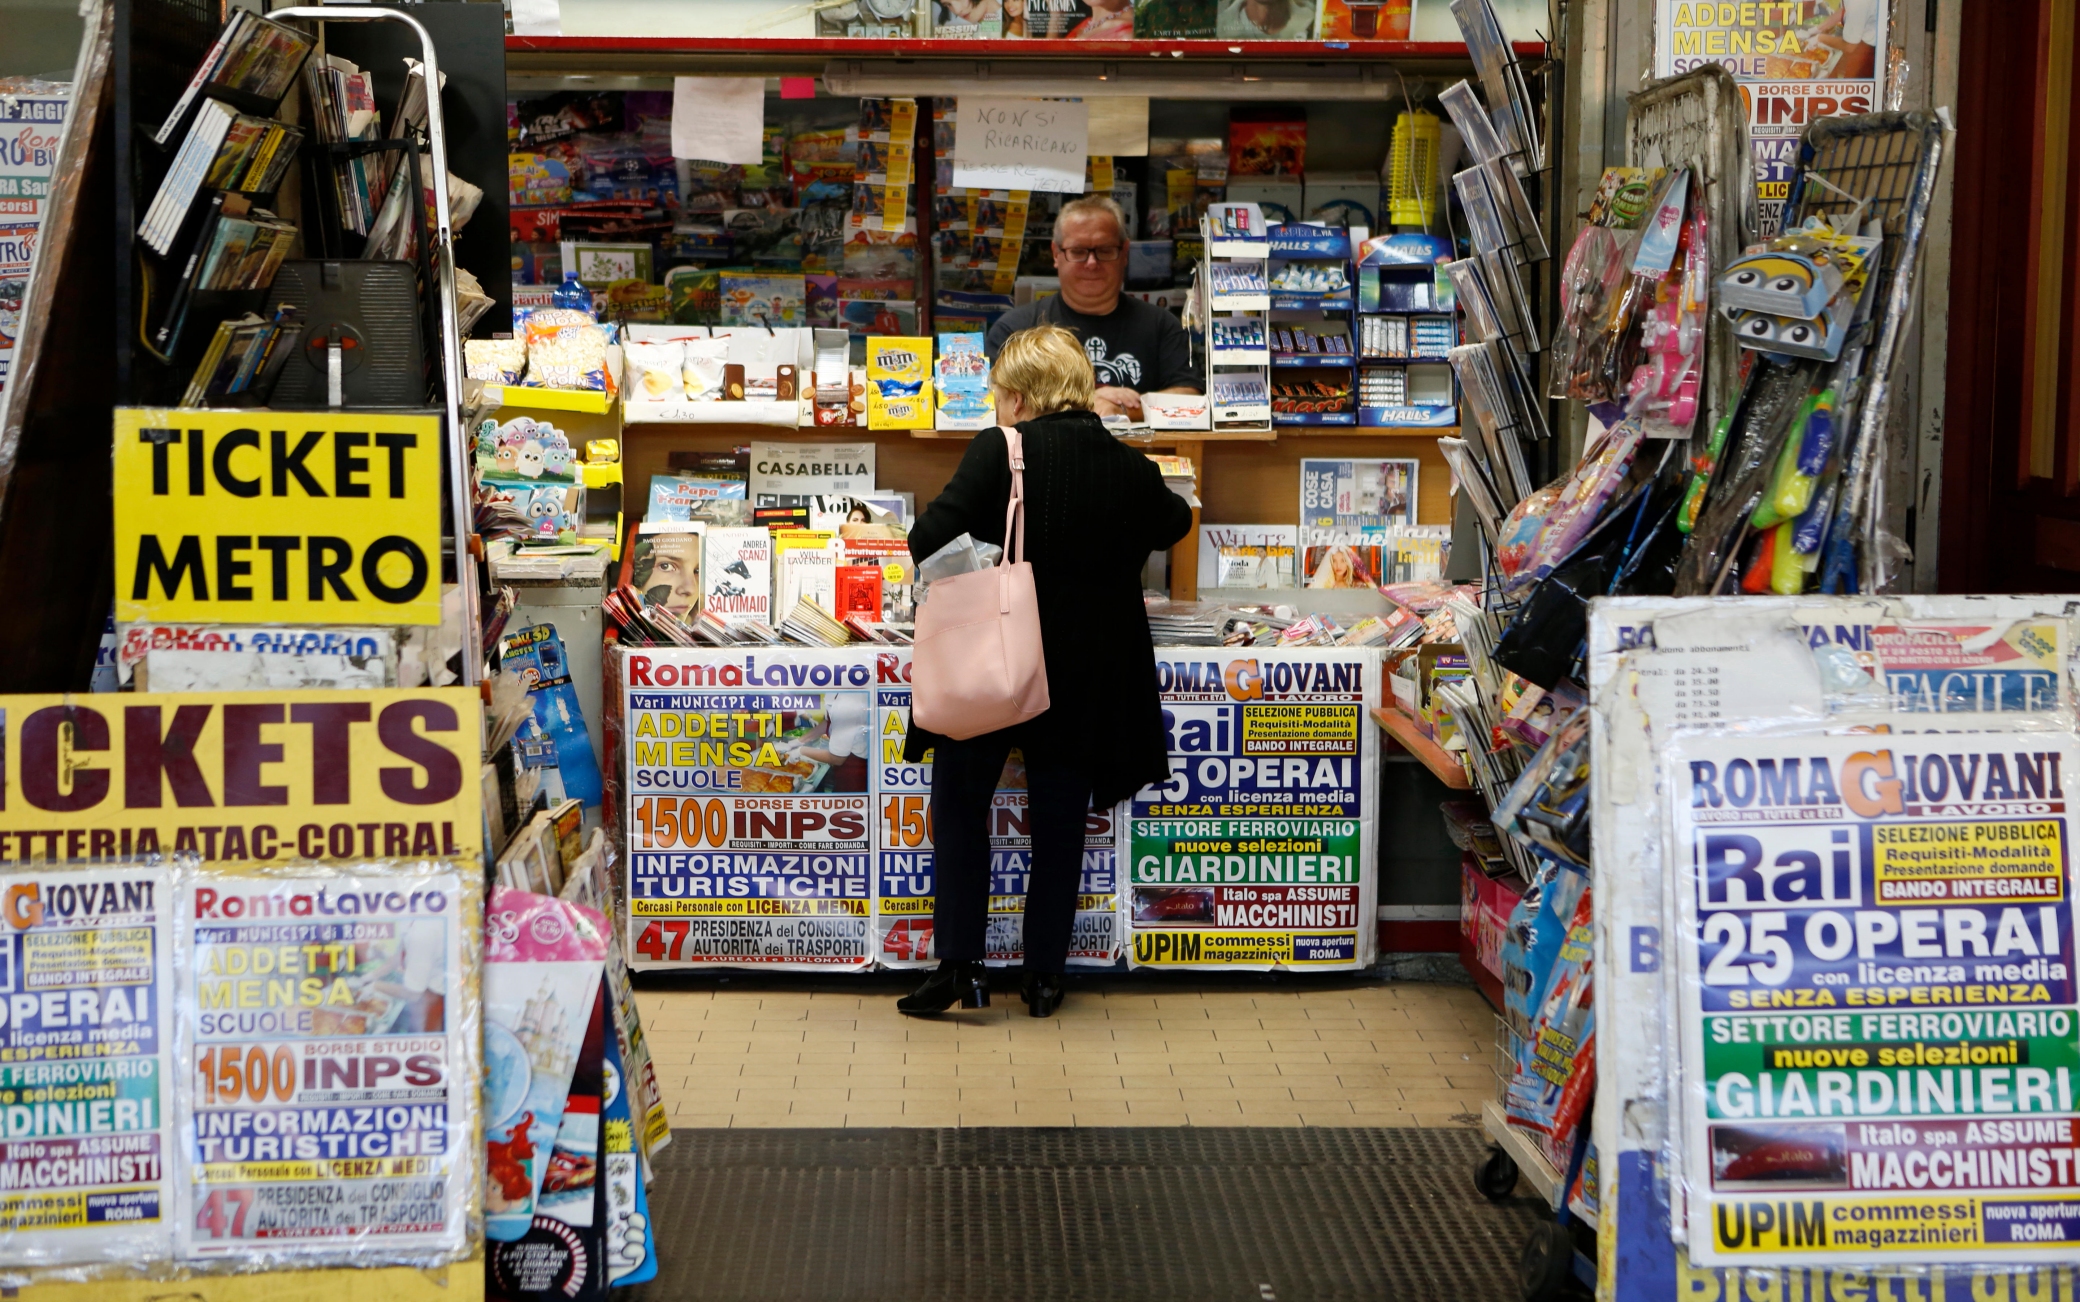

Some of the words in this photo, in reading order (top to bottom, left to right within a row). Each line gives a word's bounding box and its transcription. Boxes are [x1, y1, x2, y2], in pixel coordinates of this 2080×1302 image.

[1673, 2, 1804, 27] ADDETTI
[1673, 30, 1802, 55] MENSA
[1758, 85, 1811, 96] BORSE
[1815, 84, 1871, 95] STUDIO
[978, 108, 1030, 127] NON
[1757, 97, 1870, 124] INPS
[1754, 127, 1781, 135] REQUISITI
[1269, 241, 1310, 251] HALLS
[1384, 246, 1432, 256] HALLS
[547, 374, 590, 388] CORN
[1381, 410, 1430, 422] HALLS
[140, 428, 418, 499] TICKET
[757, 461, 869, 476] CASABELLA
[678, 484, 719, 498] Papa
[1305, 471, 1319, 509] COSE
[1320, 471, 1334, 509] CASA
[738, 549, 768, 561] SCANZI
[742, 540, 767, 549] ANDREA
[132, 534, 430, 604] METRO
[788, 557, 832, 565] LAVENDER
[709, 595, 767, 614] SALVIMAIO
[630, 655, 871, 687] RomaLavoro
[1156, 658, 1362, 702] OMAGIOVANI
[634, 695, 665, 709] Vari
[671, 695, 746, 710] MUNICIPI
[752, 695, 765, 709] di
[772, 695, 815, 709] ROMA
[1245, 707, 1302, 718] SELEZIONE
[1305, 707, 1356, 718] PUBBLICA
[636, 713, 783, 738] ADDETTI
[1248, 730, 1310, 738] Presentazione
[1313, 730, 1353, 738] domande
[1250, 720, 1351, 729] Requisiti-Modalità
[0, 699, 464, 813] CKETS
[636, 742, 783, 767] MENSA
[1247, 741, 1287, 751] BANDO
[1289, 740, 1353, 751] INTEGRALE
[636, 769, 743, 789] SCUOLE
[1198, 757, 1352, 788] OPERAI
[734, 799, 796, 810] BORSE
[799, 798, 865, 810] STUDIO
[1229, 790, 1293, 803] licenza
[1299, 790, 1355, 803] media
[1149, 805, 1213, 816] SENZA
[1219, 804, 1344, 816] ESPERIENZA
[636, 797, 728, 848] 1500
[733, 811, 866, 840] INPS
[1137, 821, 1222, 837] SETTORE
[1229, 821, 1355, 837] FERROVIARIO
[1877, 827, 1969, 843] SELEZIONE
[1975, 824, 2057, 842] PUBBLICA
[173, 821, 462, 861] ATAC-COTRAL
[731, 841, 762, 849] REQUISITI
[767, 841, 793, 849] IMPORTI
[1174, 841, 1231, 853] nuove
[1238, 838, 1322, 853] selezioni
[1886, 844, 2051, 862] Requisiti-Modalità
[637, 855, 865, 875] INFORMAZIONI
[1138, 855, 1352, 883] GIARDINIERI
[1706, 829, 1851, 904] Rai
[637, 877, 866, 897] TURISTICHE
[1223, 888, 1257, 901] Italo
[1286, 887, 1351, 901] ASSUME
[1881, 882, 1946, 898] BANDO
[1951, 879, 2058, 897] INTEGRALE
[3, 881, 155, 930] GIOVANI
[636, 901, 673, 912] Cercasi
[676, 901, 723, 913] Personale
[726, 903, 743, 912] con
[747, 900, 809, 915] LICENZA
[817, 900, 866, 914] MEDIA
[1217, 904, 1355, 927] MACCHINISTI
[237, 926, 321, 941] MUNICIPI
[341, 924, 389, 938] ROMA
[636, 920, 691, 960] 47
[692, 920, 773, 938] PRESIDENZA
[776, 923, 794, 938] del
[797, 920, 866, 938] CONSIGLIO
[1204, 933, 1290, 947] commessi
[764, 941, 784, 956] dei
[788, 939, 865, 956] TRASPORTI
[1135, 933, 1200, 962] UPIM
[1309, 949, 1341, 960] ROMA
[1703, 912, 1795, 986] 25
[1804, 907, 2060, 960] OPERAI
[199, 945, 356, 976] ADDETTI
[783, 956, 855, 964] DIPLOMATI
[28, 972, 75, 986] BANDO
[76, 967, 149, 984] INTEGRALE
[1858, 963, 1966, 985] licenza
[1974, 961, 2068, 982] media
[200, 978, 355, 1009] MENSA
[0, 987, 148, 1029] PERAI
[201, 1010, 313, 1035] SCUOLE
[1711, 1016, 1852, 1044] SETTORE
[1862, 1011, 2071, 1040] FERROVIARIO
[10, 1030, 82, 1047] licenza
[89, 1025, 153, 1042] media
[11, 1059, 153, 1086] FERROVIARIO
[199, 1045, 296, 1104] 1500
[304, 1056, 442, 1090] INPS
[22, 1081, 117, 1104] selezioni
[1714, 1067, 2072, 1119] GIARDINIERI
[198, 1105, 444, 1137] INFORMAZIONI
[1965, 1121, 2072, 1145] ASSUME
[198, 1130, 445, 1162] TURISTICHE
[0, 1155, 158, 1190] MACCHINISTI
[317, 1160, 384, 1177] LICENZA
[104, 1208, 143, 1221] ROMA
[196, 1189, 255, 1238] 47
[258, 1186, 344, 1207] PRESIDENZA
[1717, 1201, 1828, 1249] UPIM
[1832, 1199, 1978, 1222] commessi
[1833, 1224, 1978, 1248] magazzinieri
